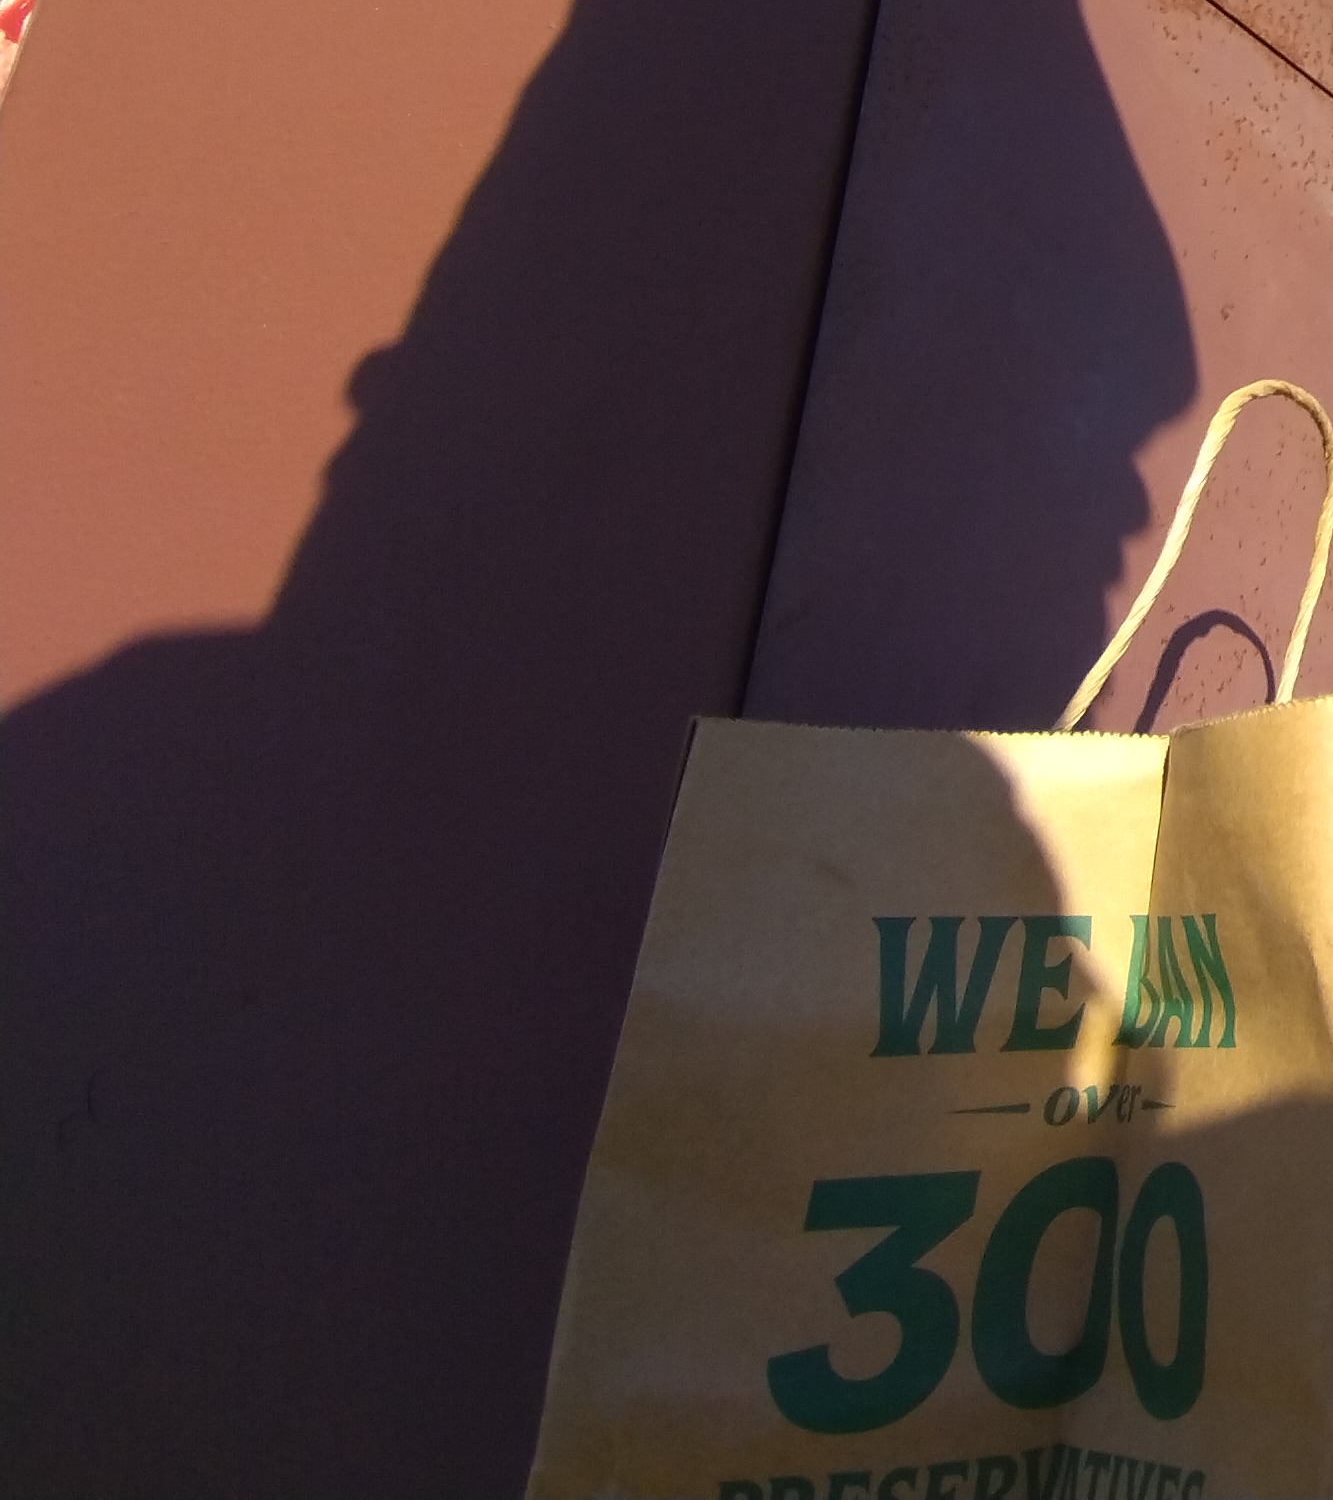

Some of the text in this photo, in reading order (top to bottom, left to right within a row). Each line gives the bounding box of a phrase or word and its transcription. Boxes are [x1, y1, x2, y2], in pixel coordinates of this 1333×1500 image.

[870, 913, 1236, 1058] WE BAN
[1043, 1083, 1142, 1126] over
[766, 1156, 1208, 1434] 300
